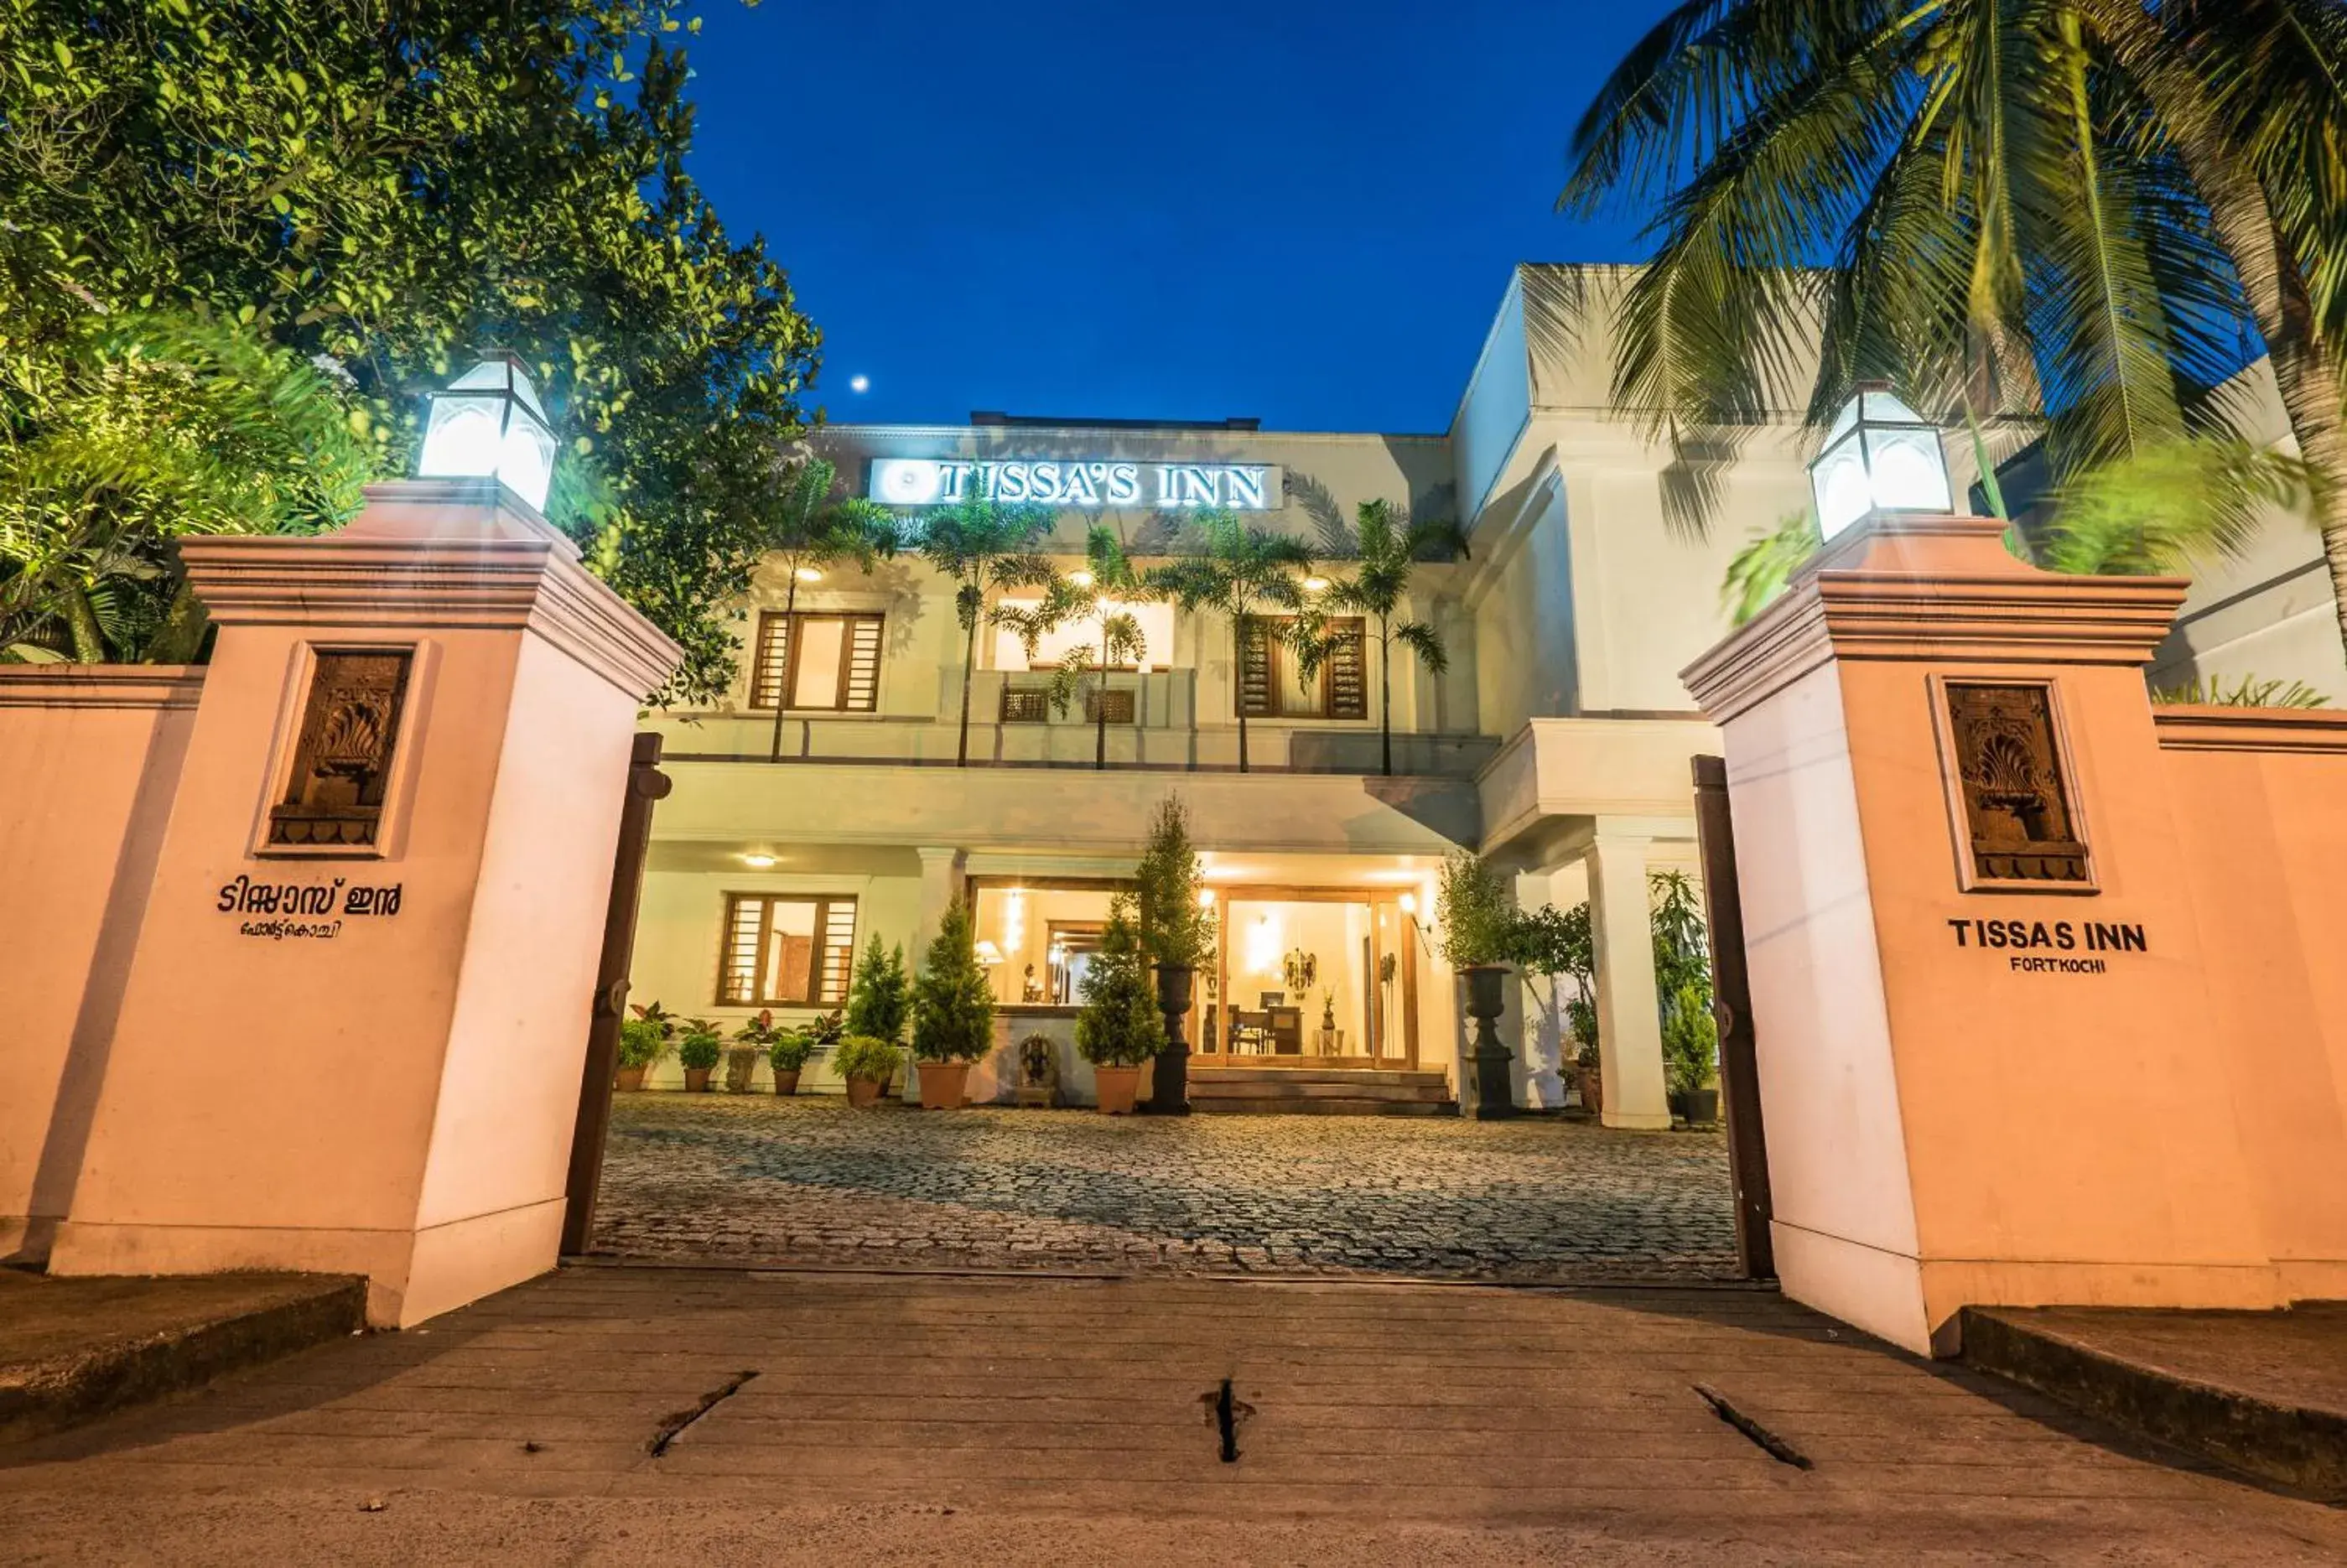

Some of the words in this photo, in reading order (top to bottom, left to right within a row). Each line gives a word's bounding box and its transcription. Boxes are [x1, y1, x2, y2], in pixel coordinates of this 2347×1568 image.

[939, 461, 1140, 504] TISSA'S
[1157, 465, 1266, 506] INN
[344, 883, 402, 916] ഇൻ
[1948, 919, 2075, 949] TISSAS
[2084, 922, 2147, 952] INN
